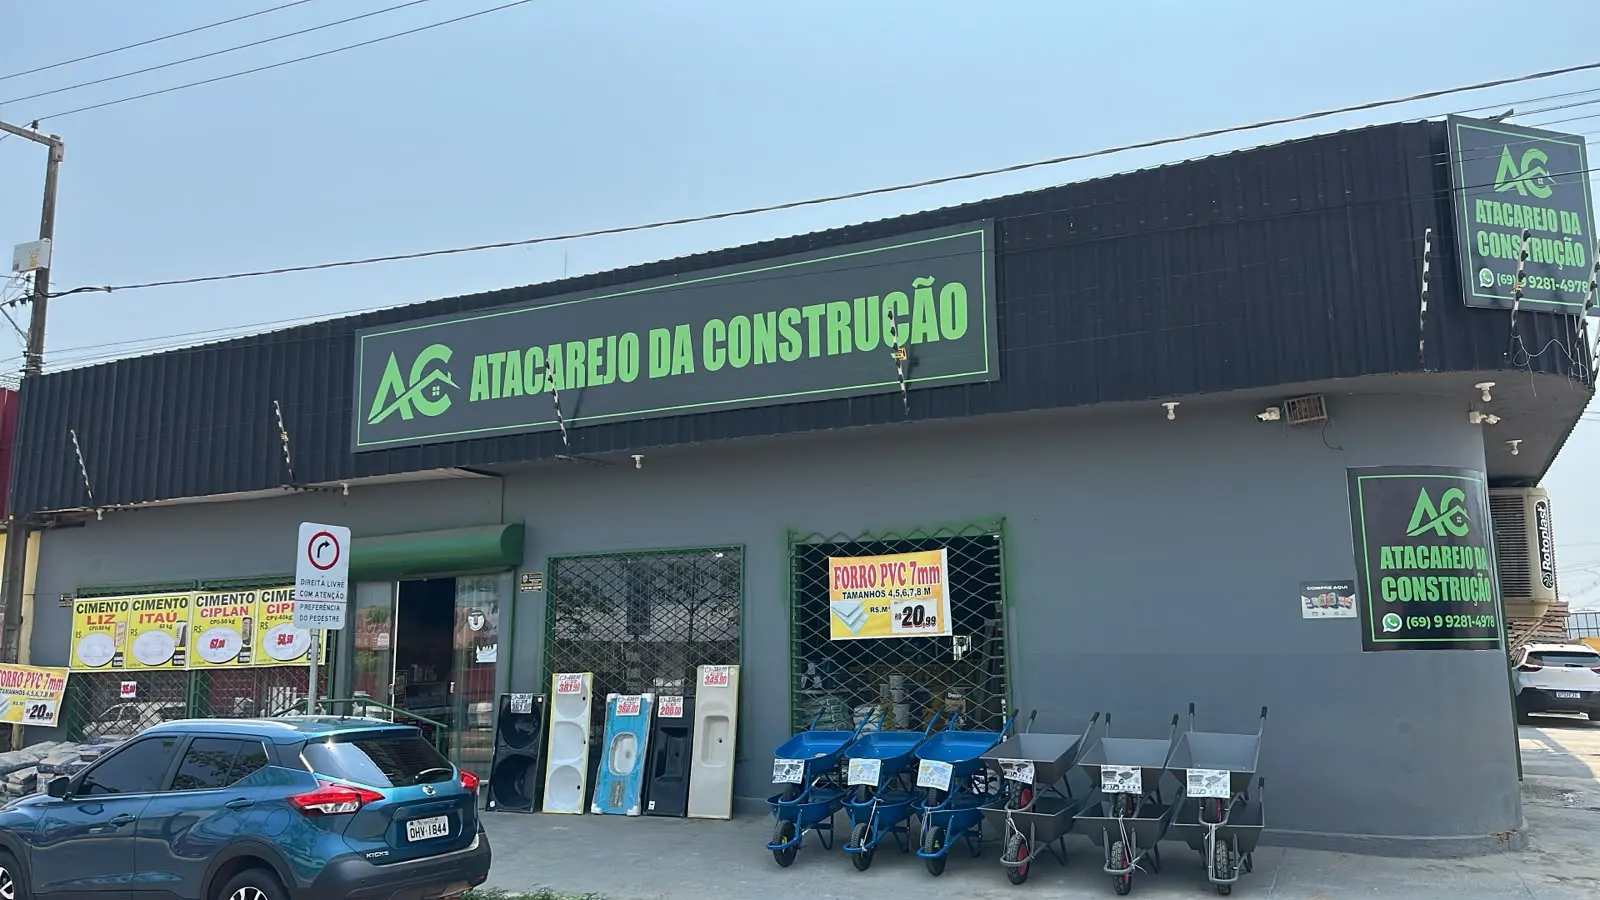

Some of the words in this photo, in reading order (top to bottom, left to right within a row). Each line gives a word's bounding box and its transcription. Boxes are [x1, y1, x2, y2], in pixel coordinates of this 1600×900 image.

[1475, 199, 1557, 233] ATACAREJO
[1560, 211, 1582, 236] DA
[1529, 275, 1589, 293] 9281-4978
[469, 332, 640, 402] ATACAREJO
[649, 324, 695, 379] DA
[702, 275, 968, 372] CONSTRUÇÃO
[368, 344, 461, 425] AC
[1406, 487, 1471, 537] AC
[1538, 505, 1552, 571] Rotoplast
[1380, 546, 1474, 570] ATACAREJO
[1474, 547, 1488, 570] DA
[301, 579, 325, 587] DIREITA
[833, 563, 877, 591] FORRO
[879, 561, 907, 588] PVC
[909, 560, 941, 587] 7mm
[261, 590, 295, 602] CIME
[315, 591, 344, 600] ATENÇÃO
[842, 589, 886, 600] TAMANHOS
[887, 587, 922, 598] 4,5,6,7,8
[923, 587, 931, 596] M
[1381, 572, 1492, 607] CONSTRUÇÃO
[76, 601, 129, 614] CIMENTO
[132, 598, 188, 611] CIMENTO
[196, 592, 255, 607] CIMENTO
[300, 602, 340, 611] PREFERÊNCIA
[87, 614, 116, 625] LIZ
[139, 610, 177, 624] ITAÚ
[200, 606, 249, 618] CIPLAN
[901, 604, 937, 628] 20,99
[1406, 616, 1431, 630] (69)
[1433, 615, 1443, 628] 9
[1445, 615, 1495, 628] 9281-4978
[24, 671, 44, 689] PVC
[43, 672, 65, 691] 7mm
[29, 703, 54, 720] 20,99
